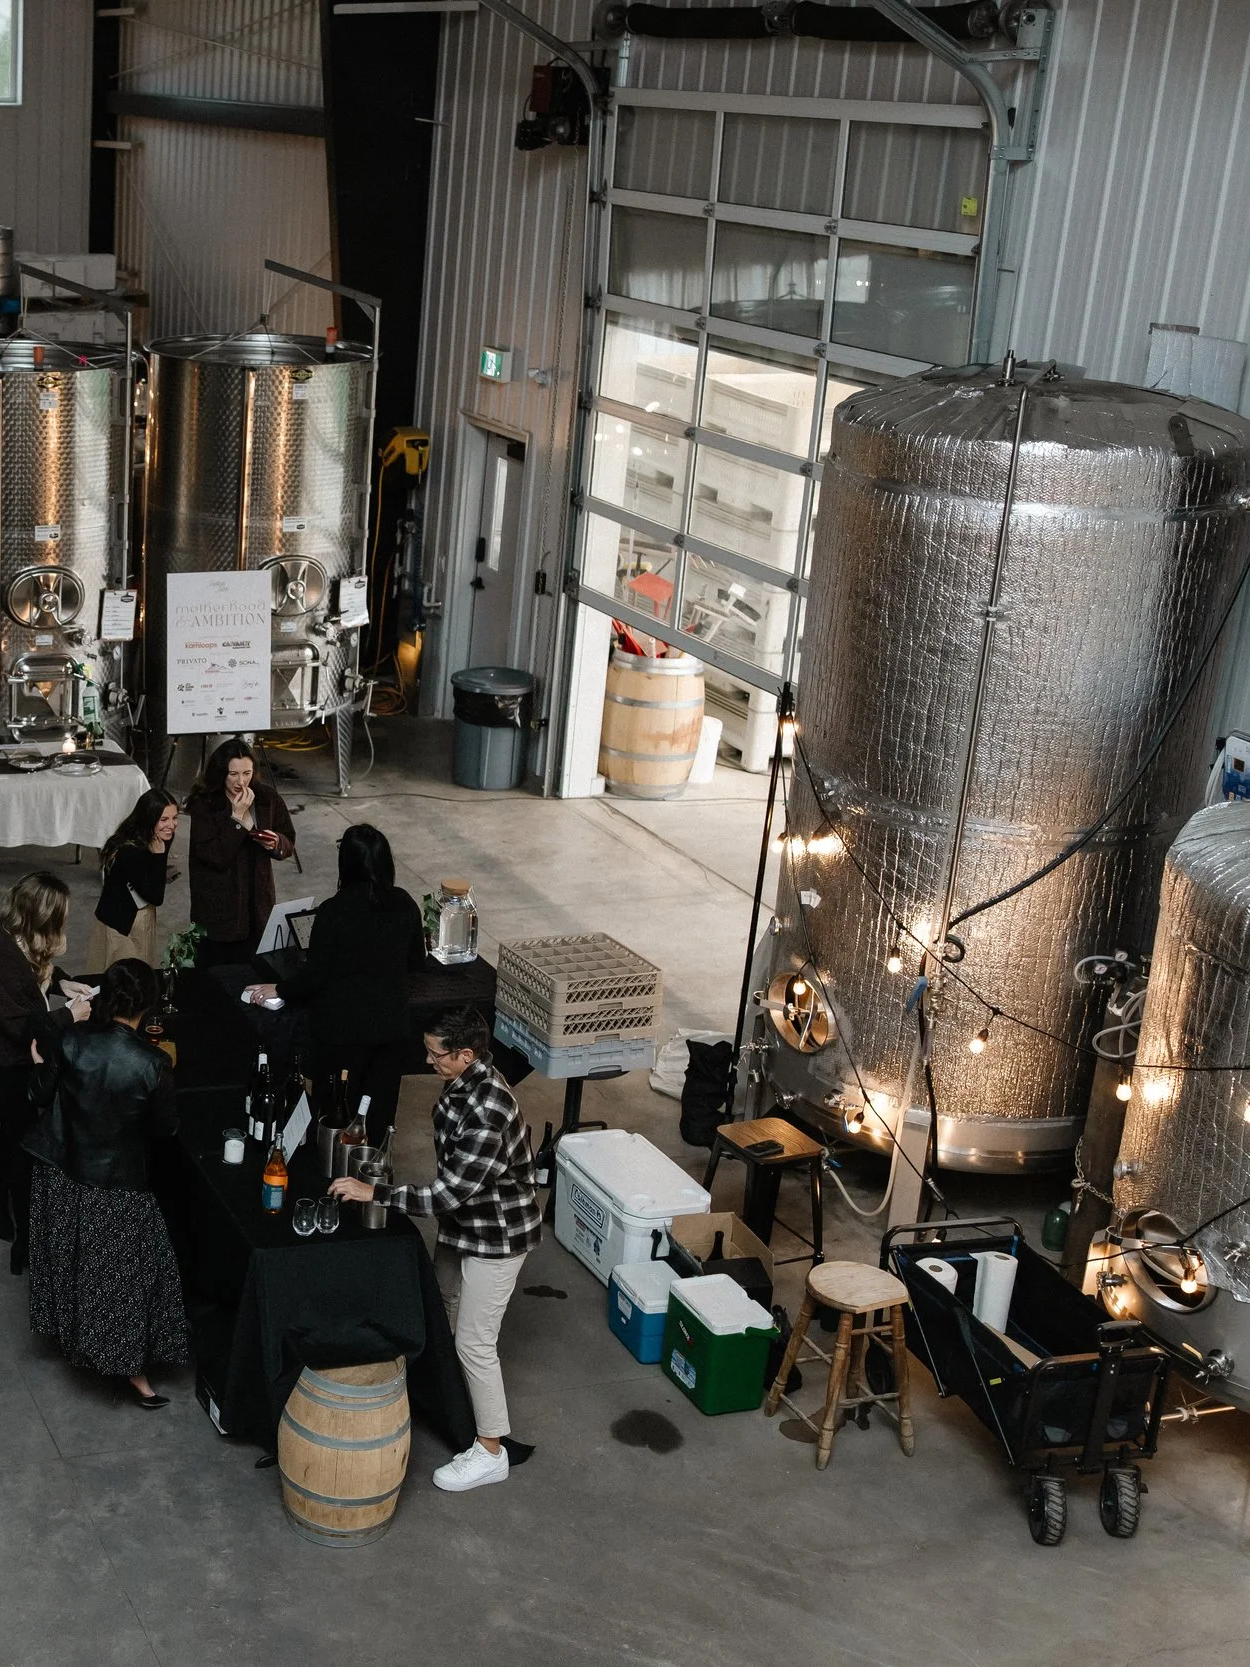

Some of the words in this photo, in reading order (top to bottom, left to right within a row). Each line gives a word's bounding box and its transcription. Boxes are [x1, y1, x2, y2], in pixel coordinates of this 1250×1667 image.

[175, 600, 266, 614] motherhood
[192, 613, 266, 627] AMBITION
[185, 642, 218, 650] kamloops
